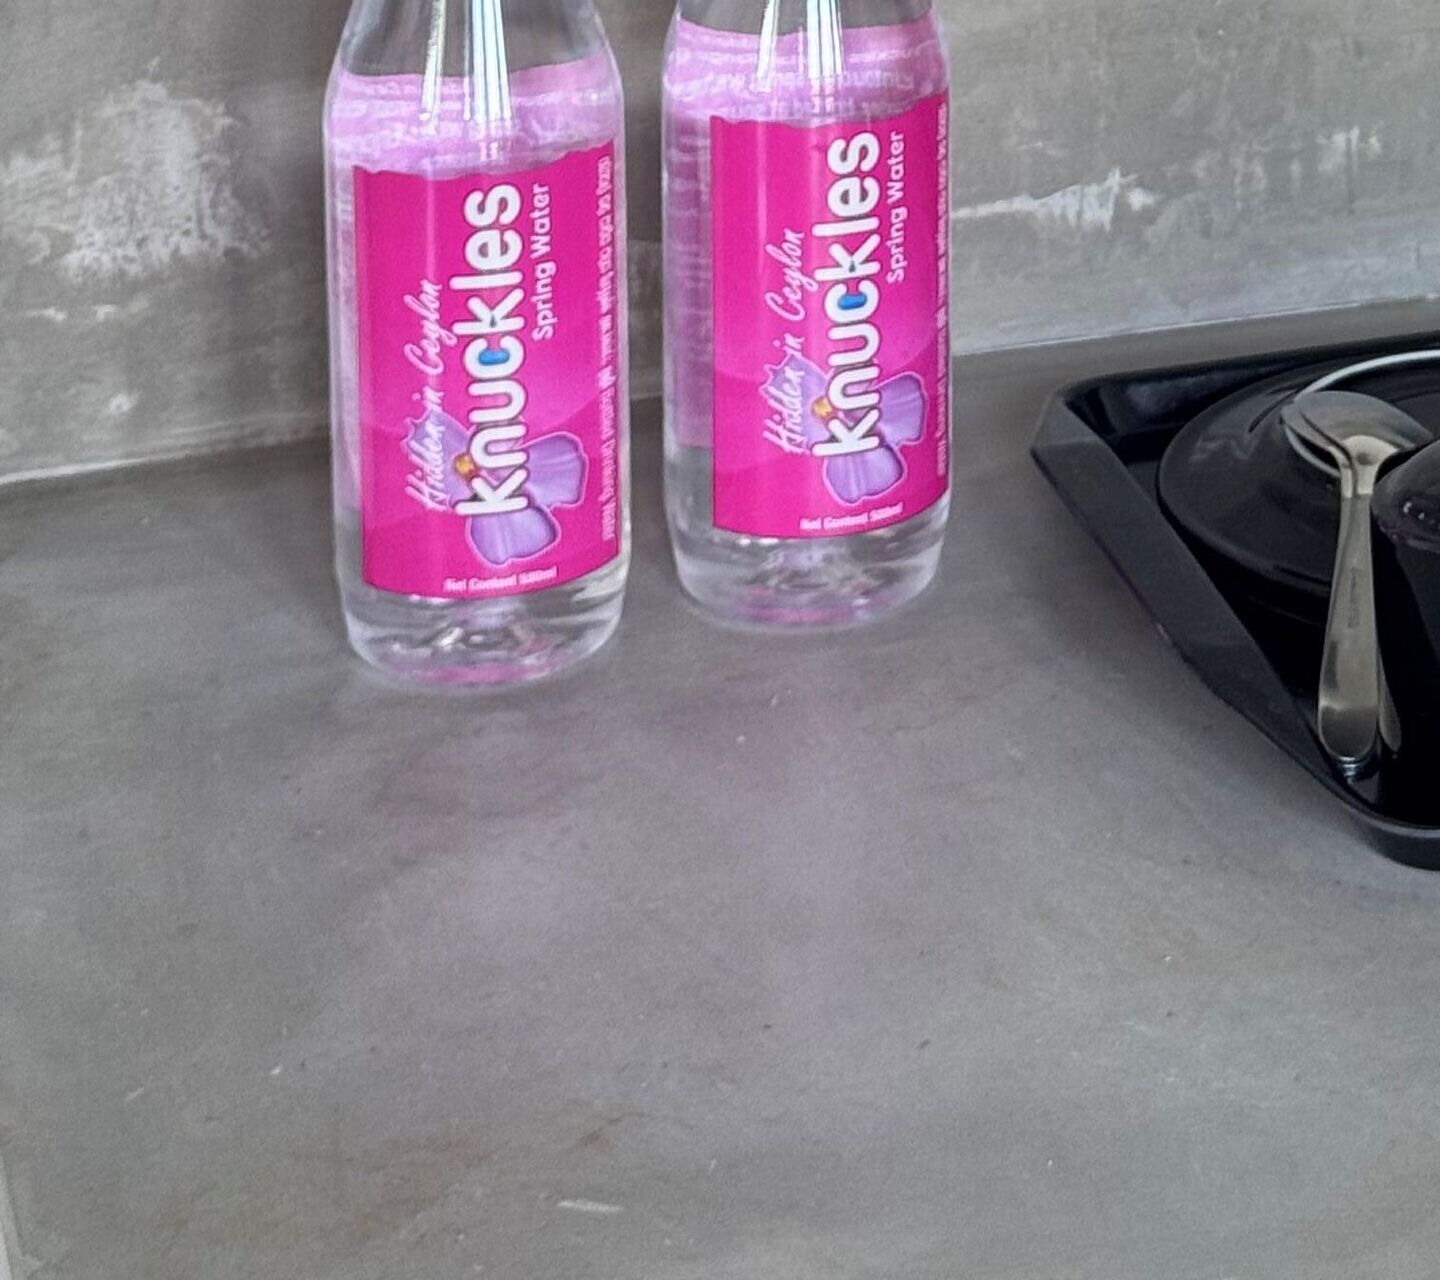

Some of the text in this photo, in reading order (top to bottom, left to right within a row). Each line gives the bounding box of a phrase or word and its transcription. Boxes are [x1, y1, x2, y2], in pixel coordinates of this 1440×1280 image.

[530, 184, 558, 341] Spring Water
[811, 131, 881, 456] knuckles
[885, 130, 908, 283] Spring Water
[403, 279, 457, 510] Hidden in Ceylon
[449, 184, 529, 516] knuckles
[762, 228, 819, 453] Hidden in Ceylon
